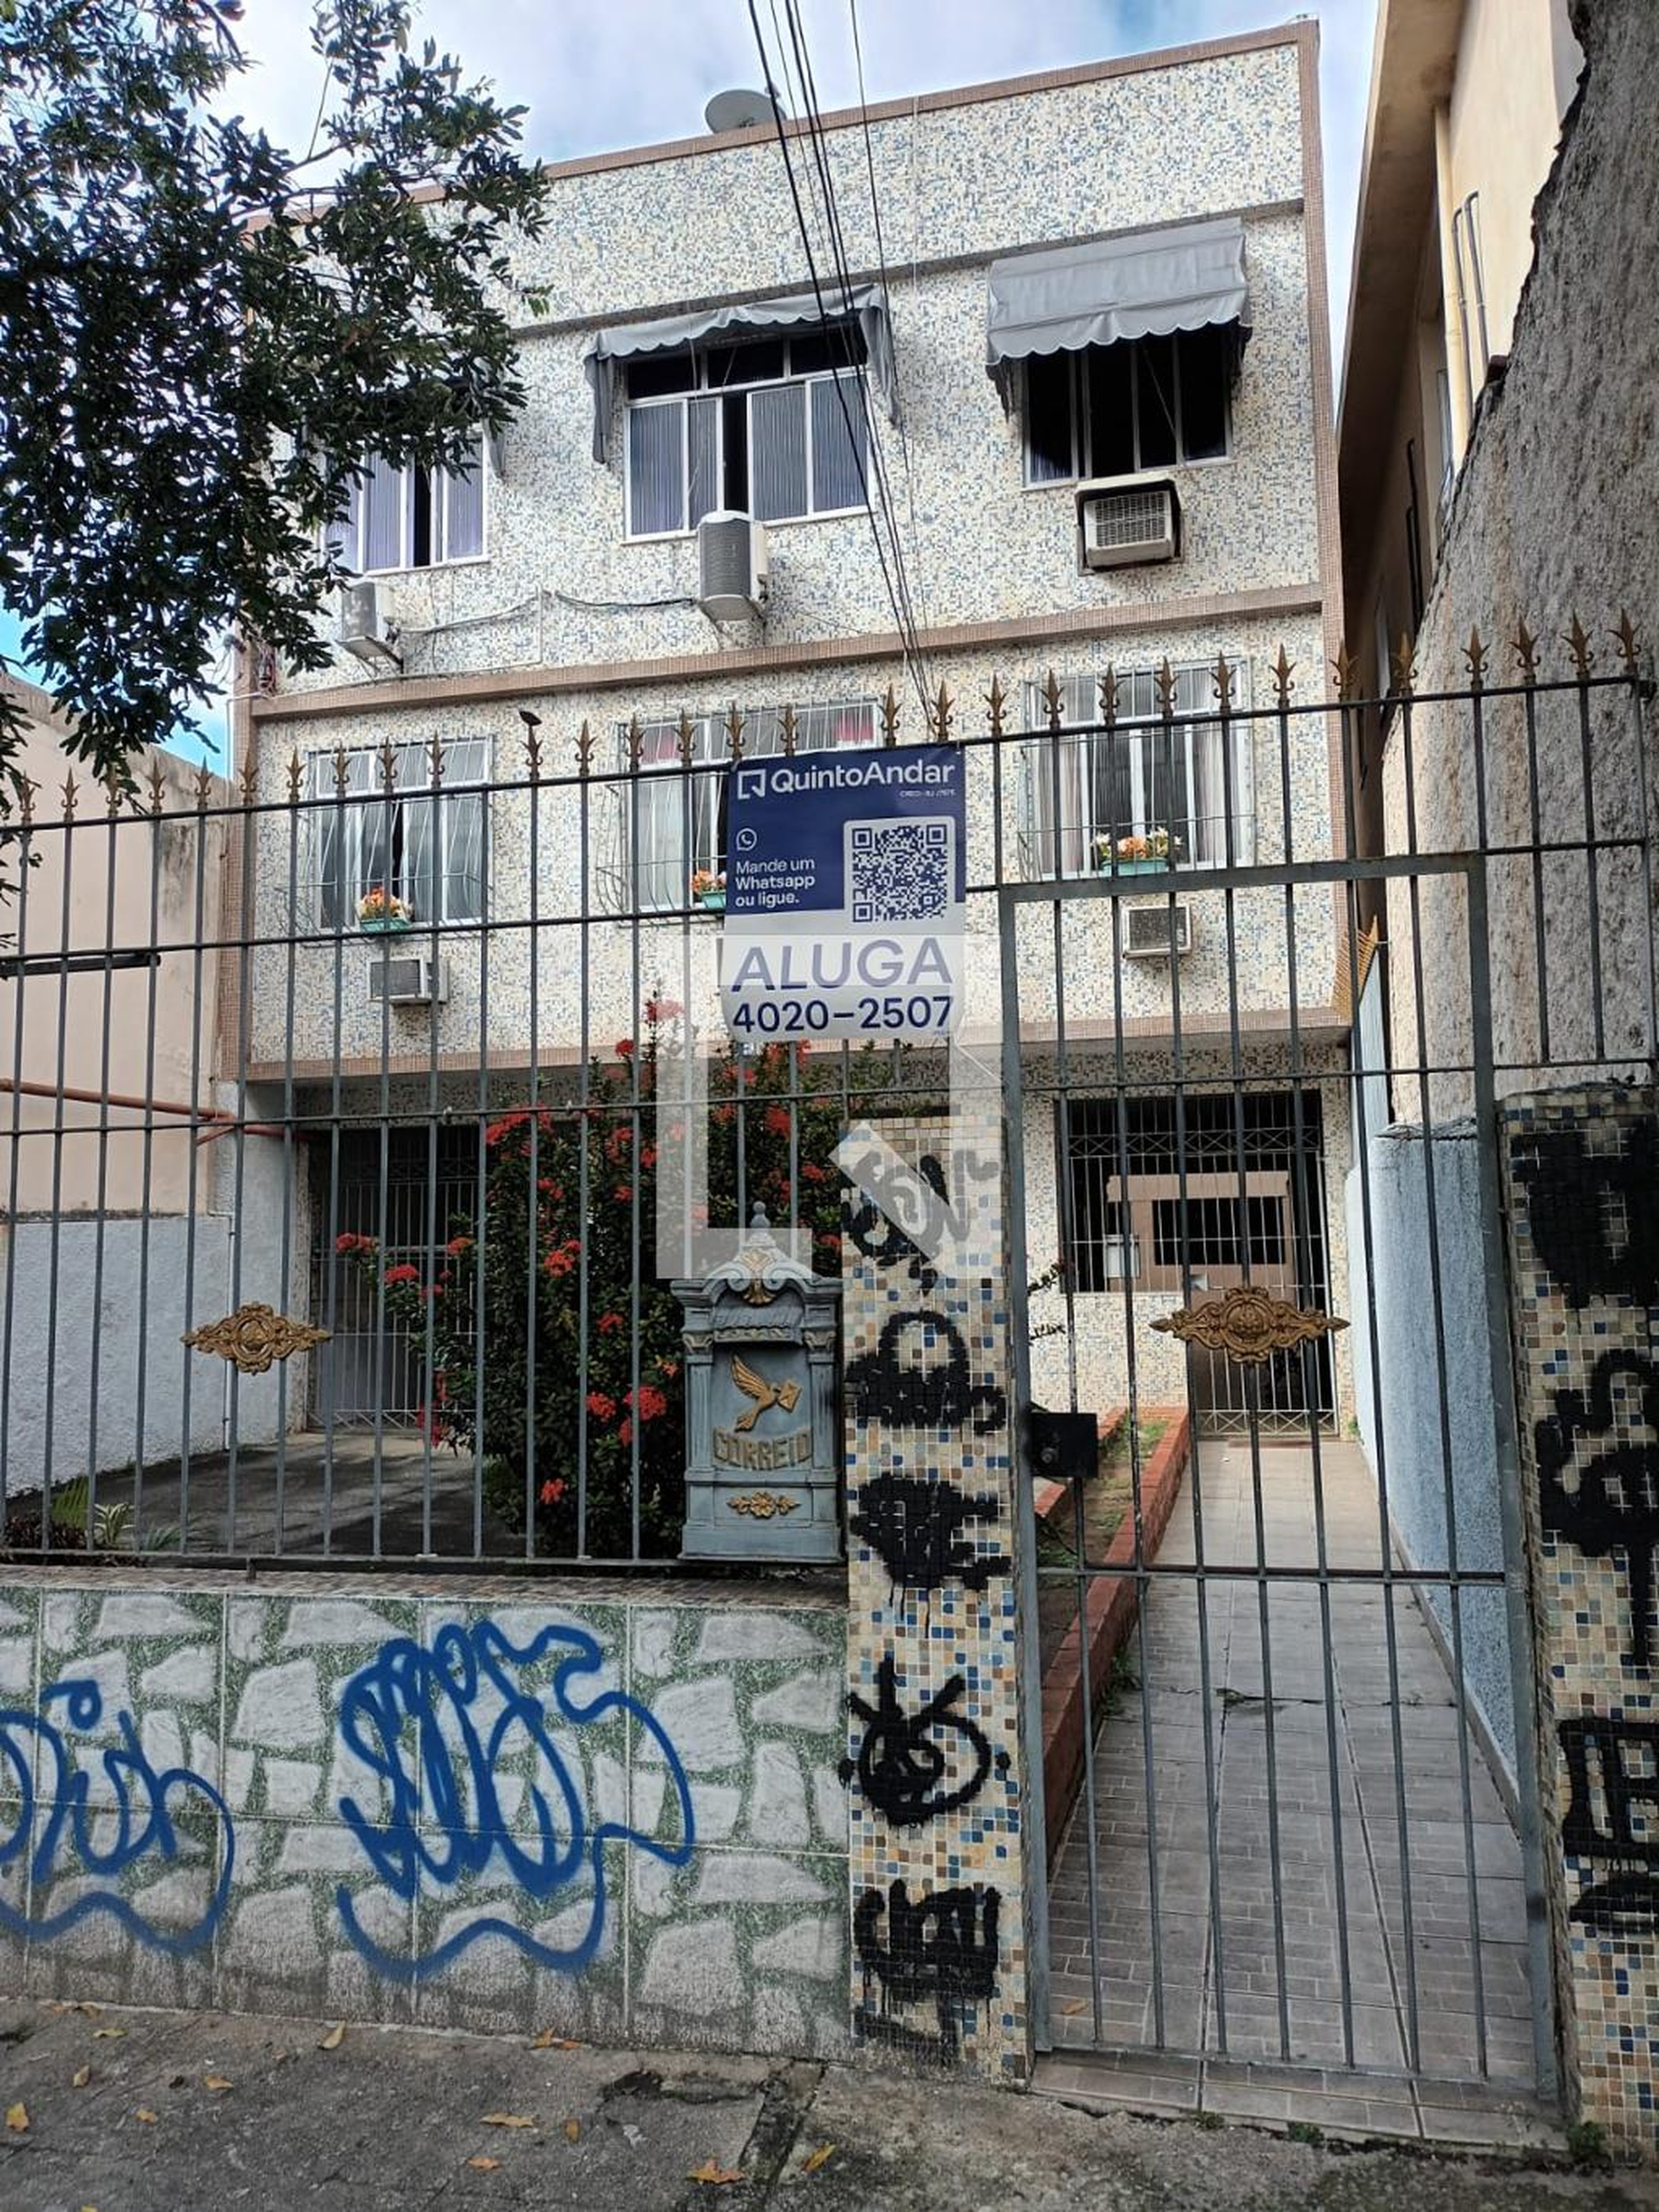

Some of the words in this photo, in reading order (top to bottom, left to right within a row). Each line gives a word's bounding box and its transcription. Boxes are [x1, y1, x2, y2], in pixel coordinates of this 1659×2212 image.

[771, 759, 955, 793] QuintoAndar
[735, 875, 816, 891] Whatsapp
[736, 858, 787, 875] Mande
[790, 858, 816, 871] um
[735, 895, 754, 907] ou
[758, 891, 800, 908] ligue.
[731, 937, 953, 992] ALUGA
[733, 995, 953, 1033] 4020-2507
[713, 1426, 812, 1470] CORREIO
